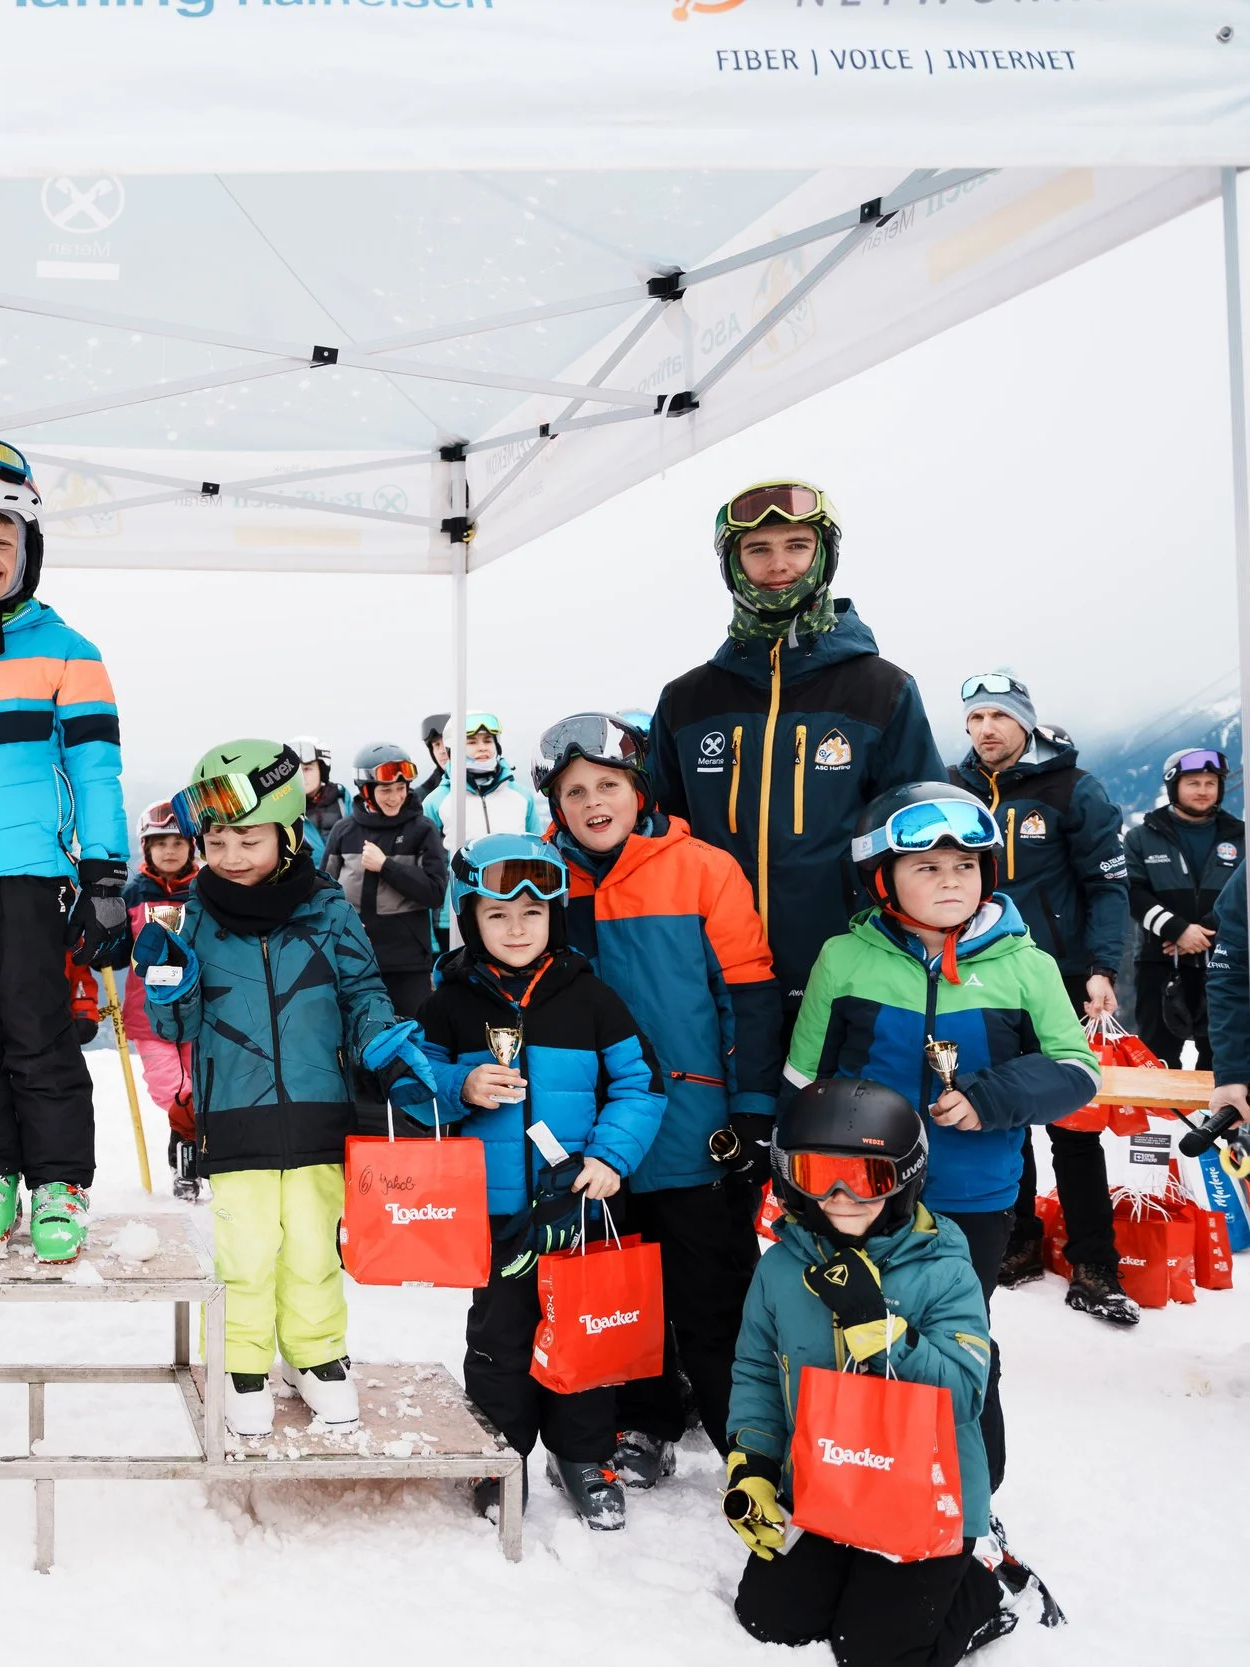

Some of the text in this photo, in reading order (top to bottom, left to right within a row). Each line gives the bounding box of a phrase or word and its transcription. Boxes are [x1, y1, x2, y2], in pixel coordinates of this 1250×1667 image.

[716, 50, 800, 72] FIBER
[830, 50, 914, 71] VOICE
[947, 49, 1077, 71] INTERNET
[259, 758, 295, 788] uvex
[272, 783, 293, 801] uvex
[902, 1153, 925, 1180] uvex
[385, 1203, 457, 1224] Loacker
[1119, 1256, 1146, 1268] cker
[579, 1309, 640, 1335] Loacker
[817, 1437, 895, 1471] Loacker
